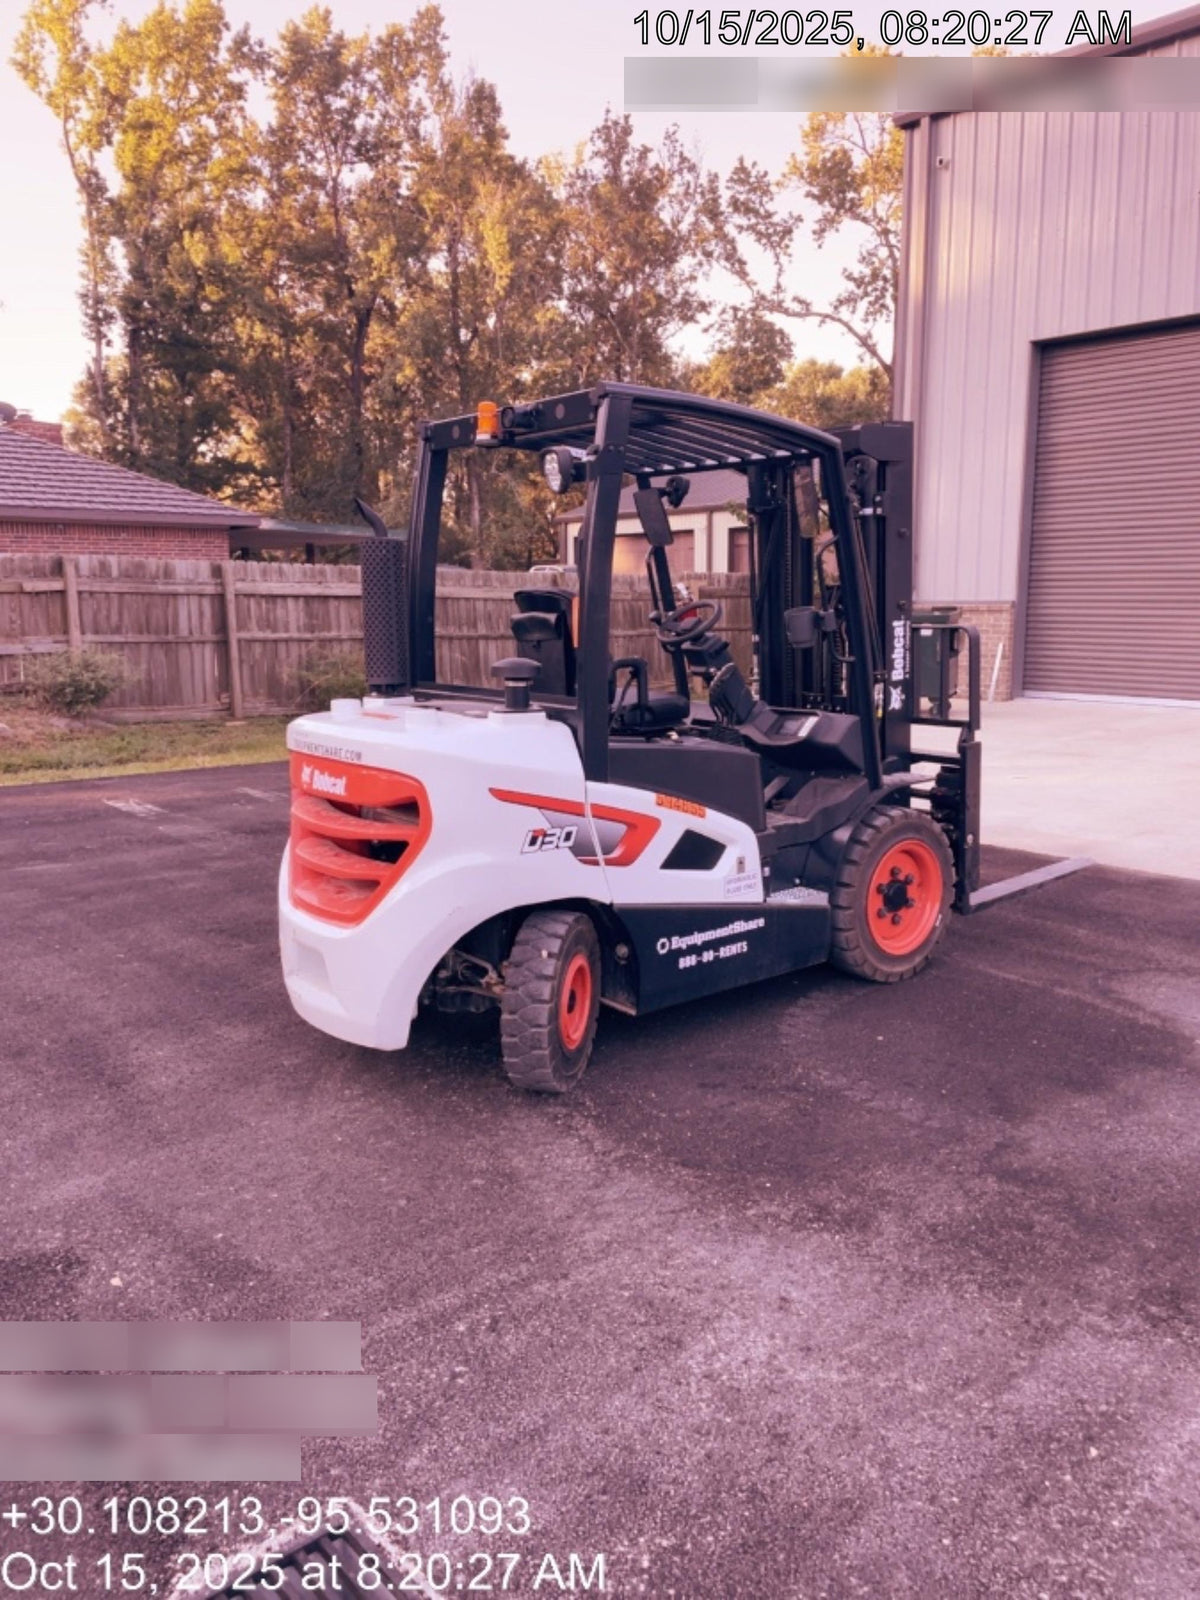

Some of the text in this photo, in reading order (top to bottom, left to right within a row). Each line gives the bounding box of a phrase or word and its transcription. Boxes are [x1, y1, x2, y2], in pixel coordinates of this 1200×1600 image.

[891, 619, 904, 681] Bobcat
[313, 769, 347, 797] Bobcat
[520, 825, 578, 854] D30
[671, 917, 765, 950] EquipmentShare
